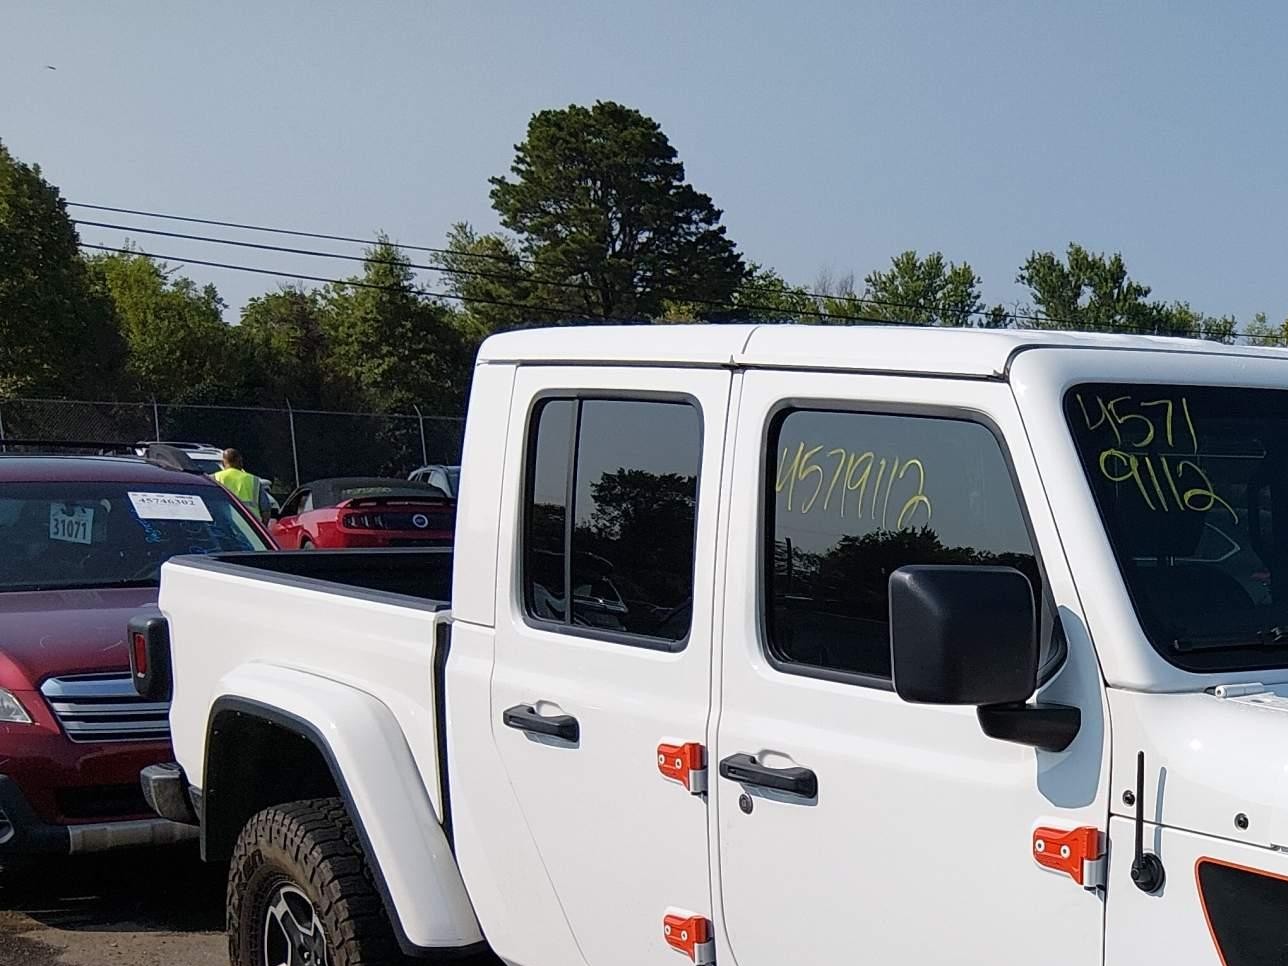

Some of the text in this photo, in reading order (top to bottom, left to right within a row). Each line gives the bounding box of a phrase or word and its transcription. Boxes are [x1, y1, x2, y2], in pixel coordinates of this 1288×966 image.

[1075, 393, 1198, 454] 4571
[775, 441, 932, 530] 45719112
[1099, 448, 1239, 525] 9112
[53, 518, 87, 540] 31071
